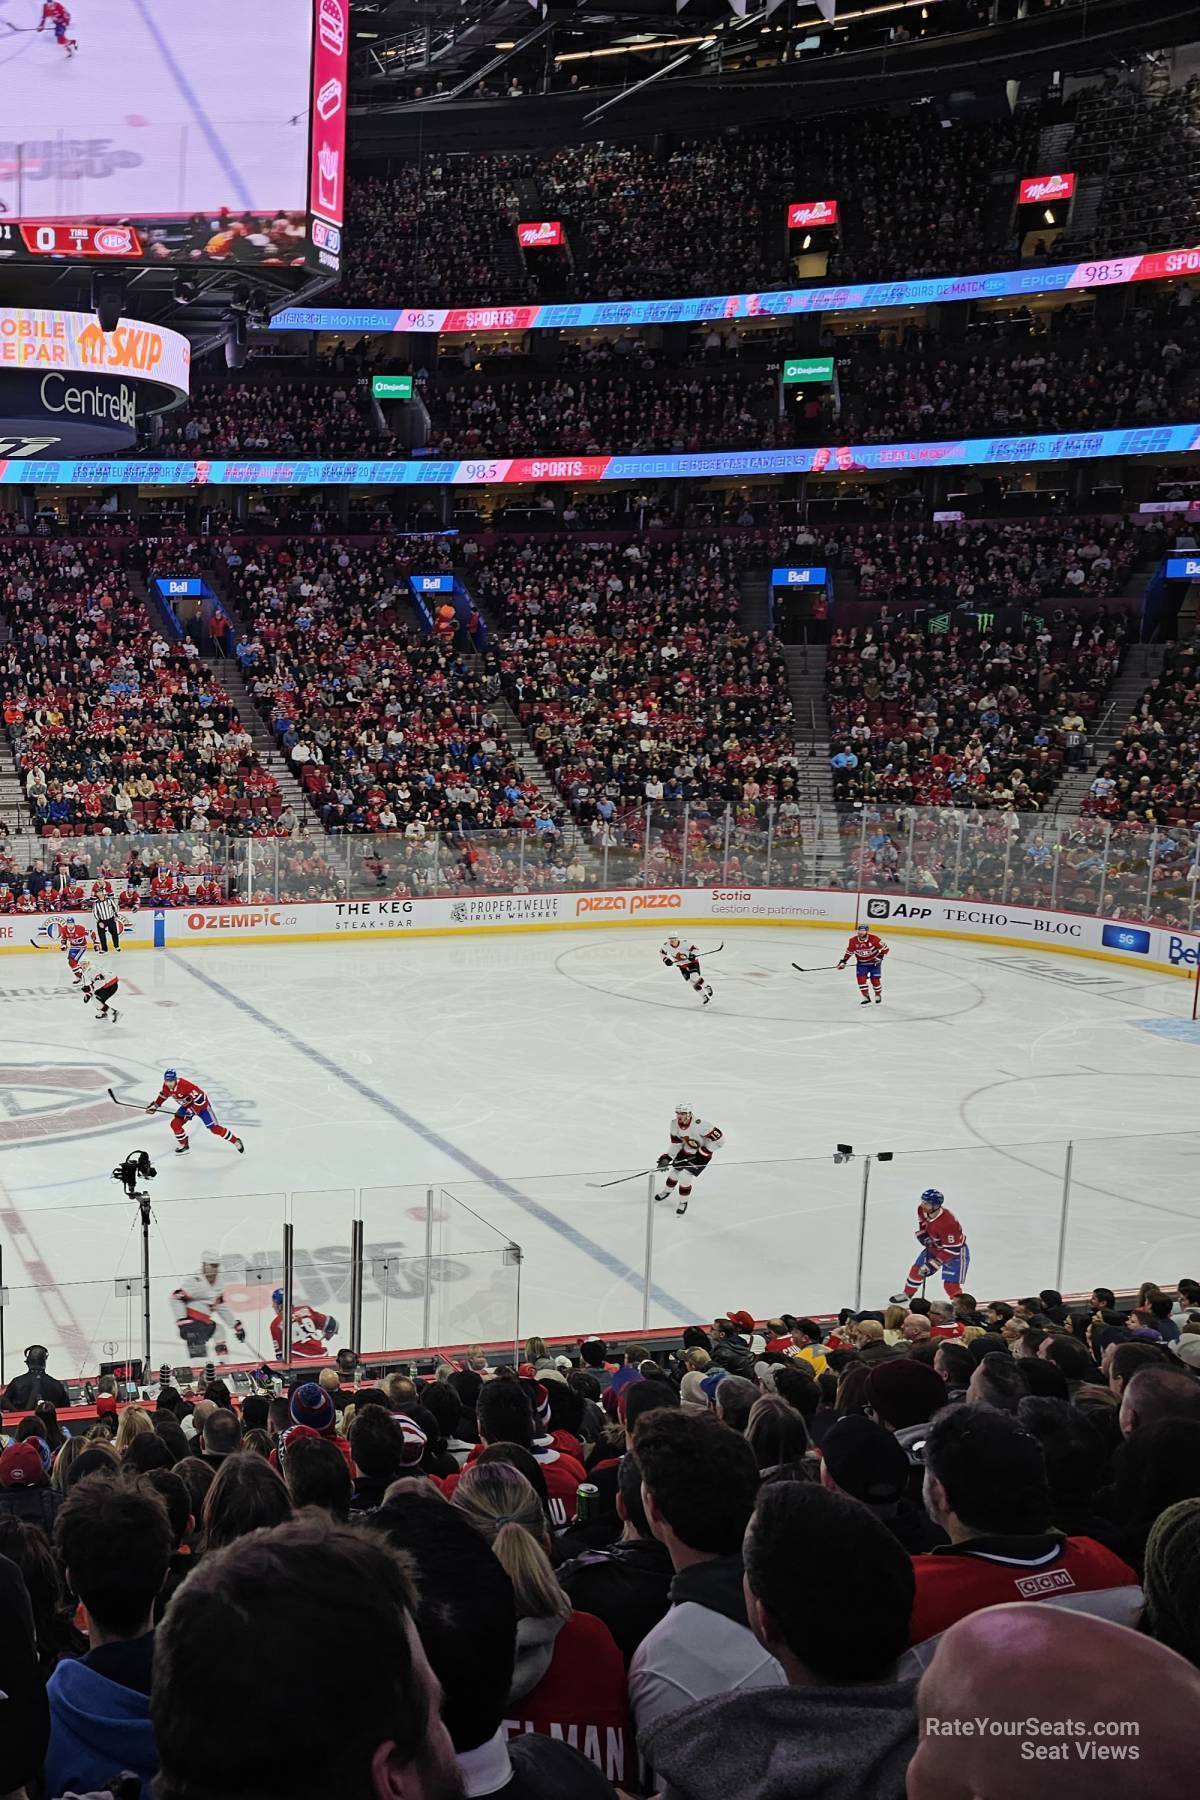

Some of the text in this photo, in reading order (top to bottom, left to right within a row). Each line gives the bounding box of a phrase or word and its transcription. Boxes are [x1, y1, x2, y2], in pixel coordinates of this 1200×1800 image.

[1024, 182, 1068, 200] Molson
[792, 209, 832, 224] Molson
[36, 226, 55, 251] 0
[521, 229, 556, 243] Molson
[75, 239, 83, 251] 1
[951, 280, 986, 294] MATCH
[407, 313, 435, 327] 98.5
[465, 311, 514, 327] SPORTS
[23, 343, 65, 362] PAR
[107, 327, 162, 371] SKIP
[797, 366, 830, 376] Desjardins
[383, 384, 409, 392] Desjardins
[1117, 428, 1173, 453] IGA
[19, 462, 60, 482] IGA
[416, 463, 456, 482] IGA
[466, 464, 498, 480] 98.5
[531, 461, 583, 478] SPORTS
[423, 578, 441, 589] Bell
[788, 570, 810, 583] Bell
[170, 582, 188, 592] Bell
[712, 889, 752, 902] Scotia
[335, 902, 413, 915] THE KEG
[470, 898, 558, 913] PROPER TWELVE
[576, 894, 682, 917] pizza pizza
[711, 903, 751, 914] Gestion
[752, 904, 766, 914] de
[470, 911, 558, 921] IRISH WHISKEY
[335, 919, 413, 930] STEAK BAR
[1118, 932, 1134, 946] 5G
[1021, 1571, 1071, 1598] CCM
